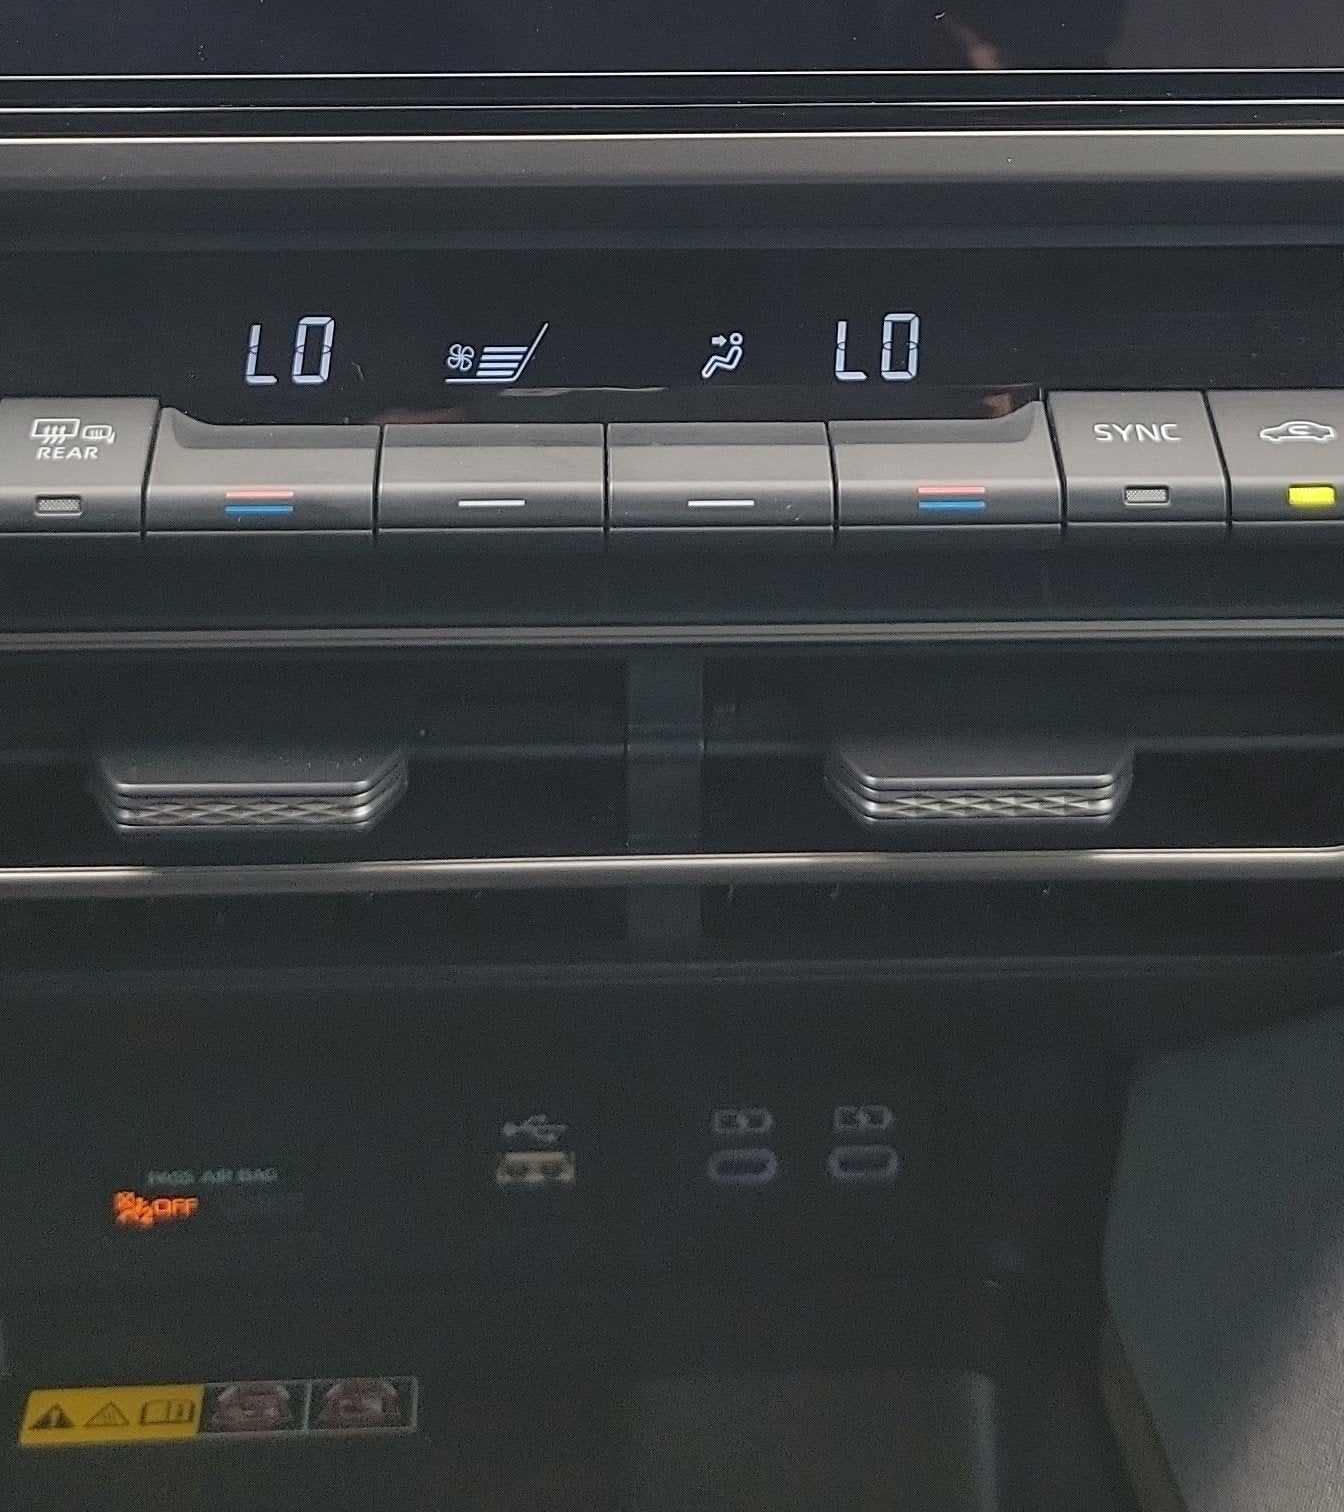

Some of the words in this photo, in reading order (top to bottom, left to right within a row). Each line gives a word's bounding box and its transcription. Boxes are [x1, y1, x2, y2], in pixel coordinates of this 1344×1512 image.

[244, 316, 335, 385] LO
[834, 311, 920, 382] LO
[1092, 422, 1181, 442] SYNC
[36, 446, 98, 461] REAR
[153, 1197, 199, 1218] OFF
